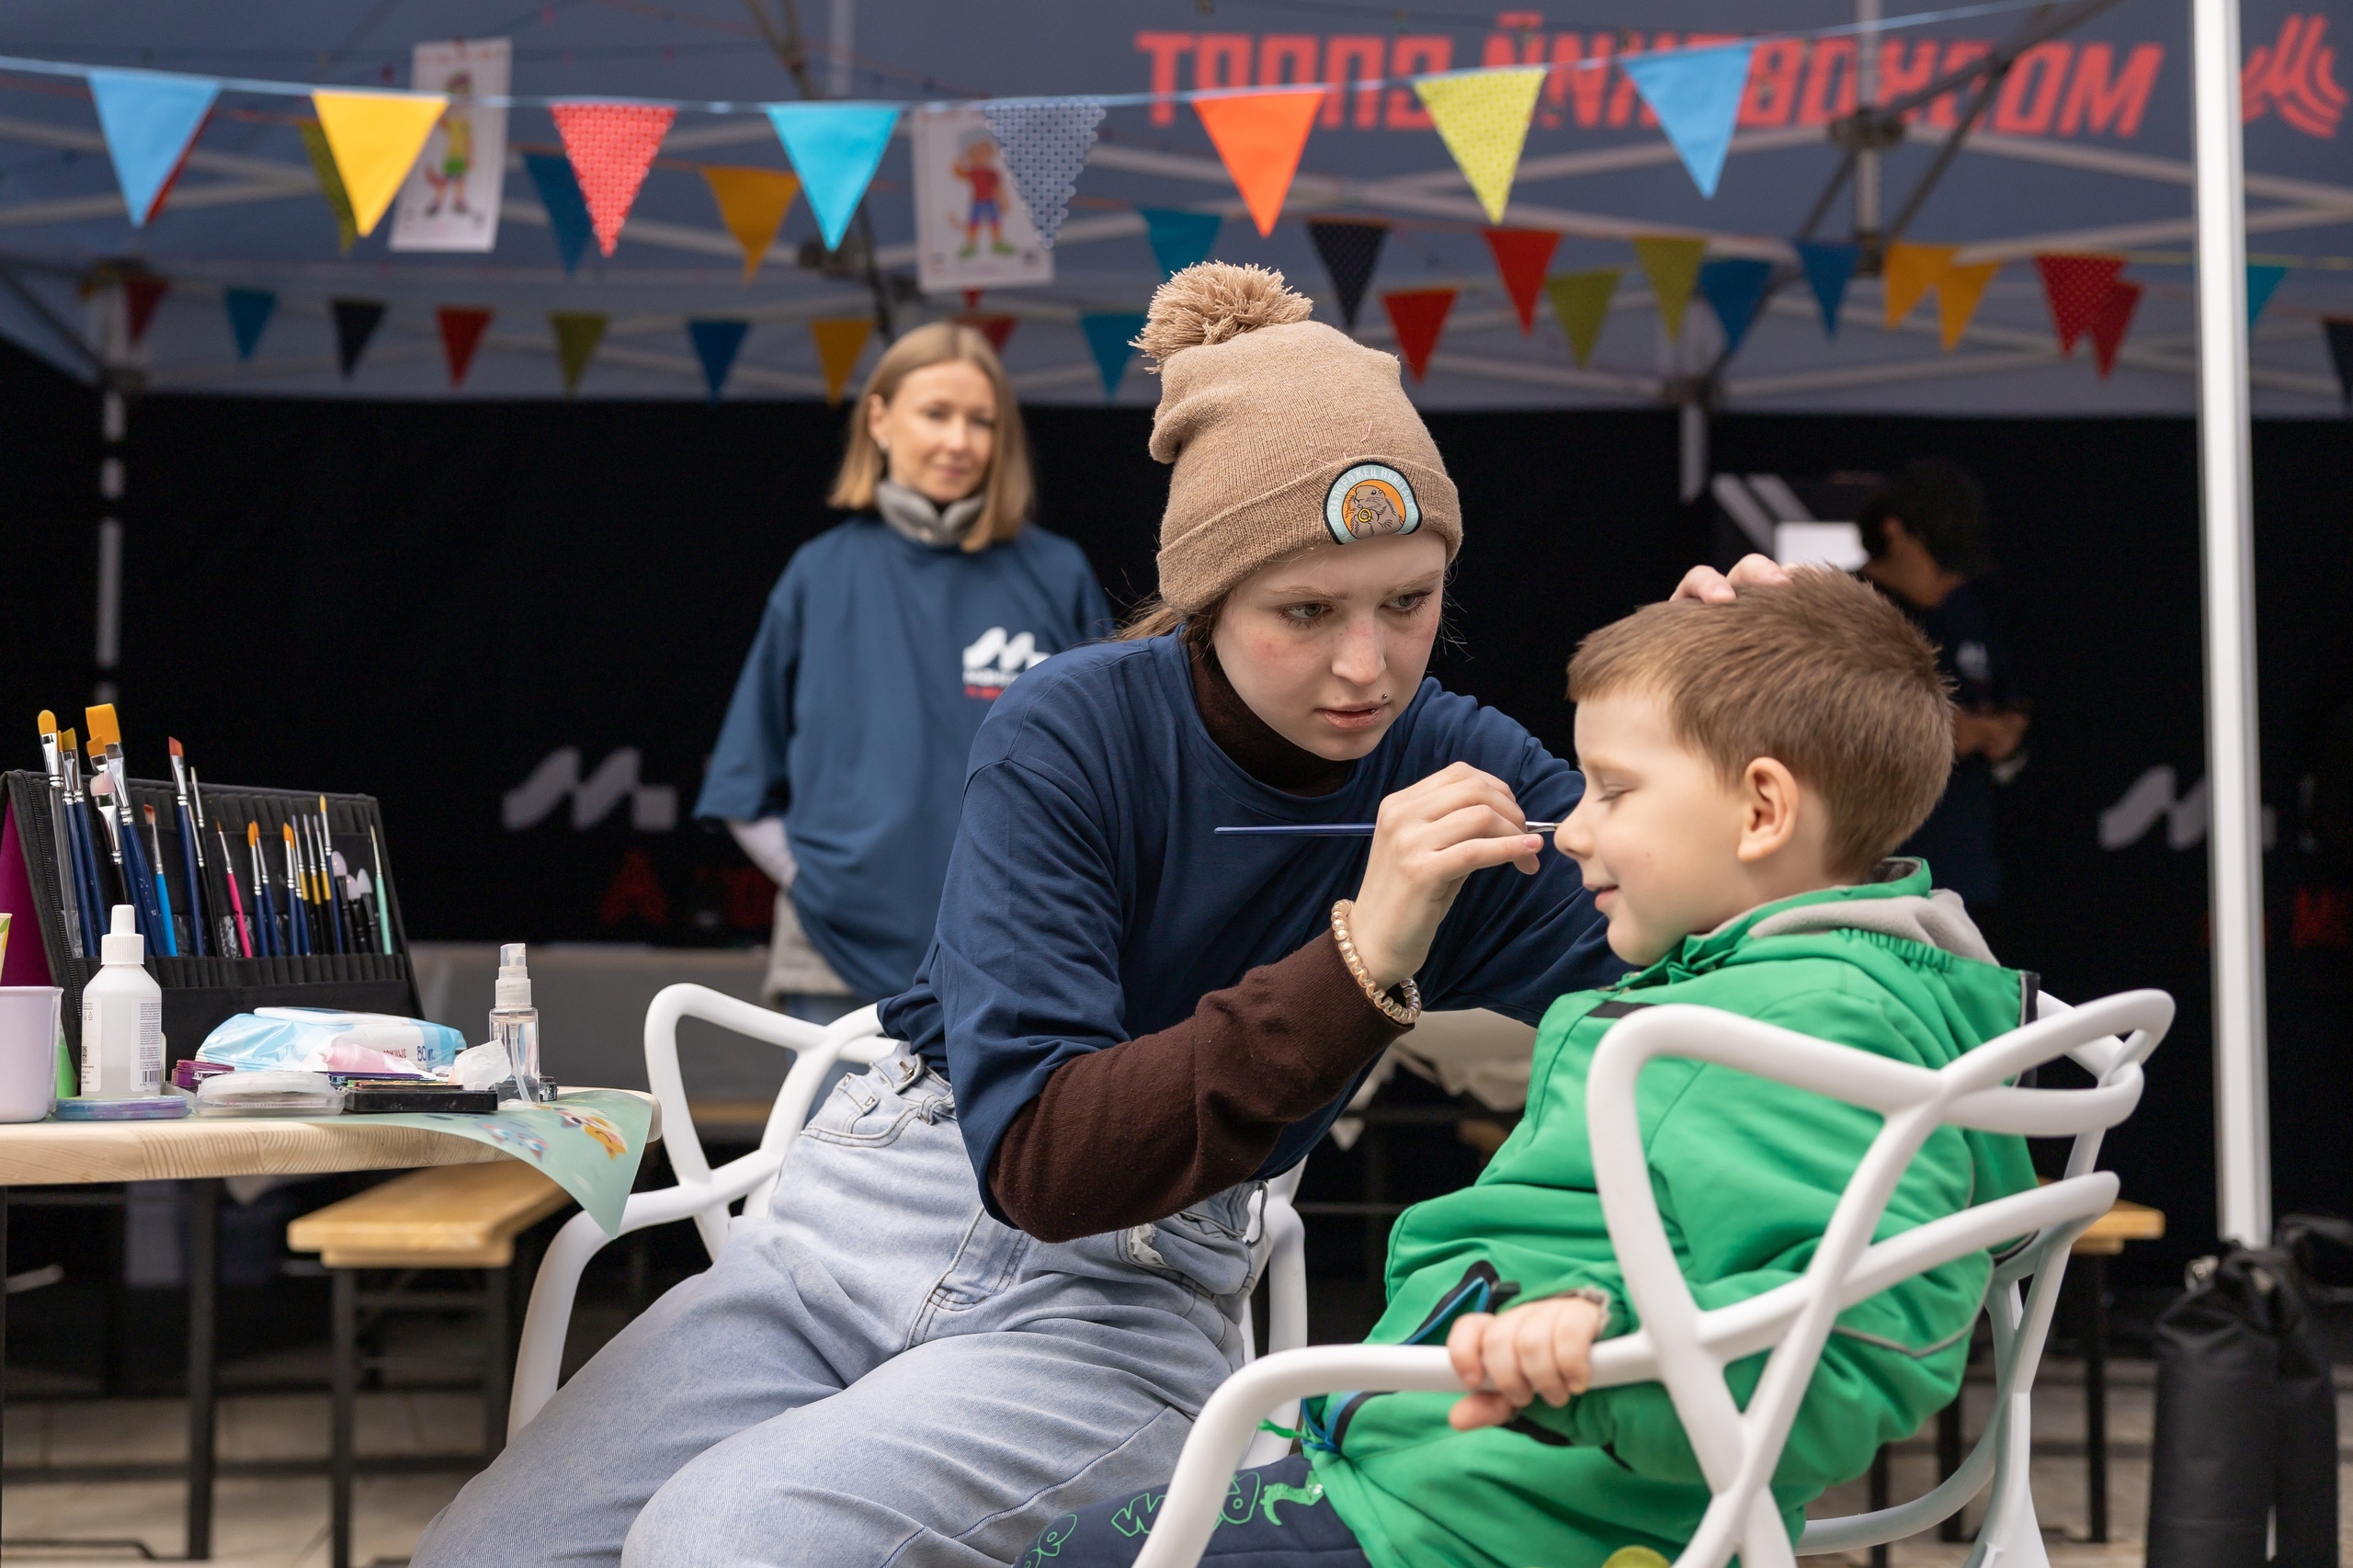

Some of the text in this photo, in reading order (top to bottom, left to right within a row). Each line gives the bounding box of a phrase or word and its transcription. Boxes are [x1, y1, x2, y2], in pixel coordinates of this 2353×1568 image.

[1329, 467, 1414, 511] ЗАПОРОЖЕЦ HERITAGE
[416, 1045, 426, 1062] 80
